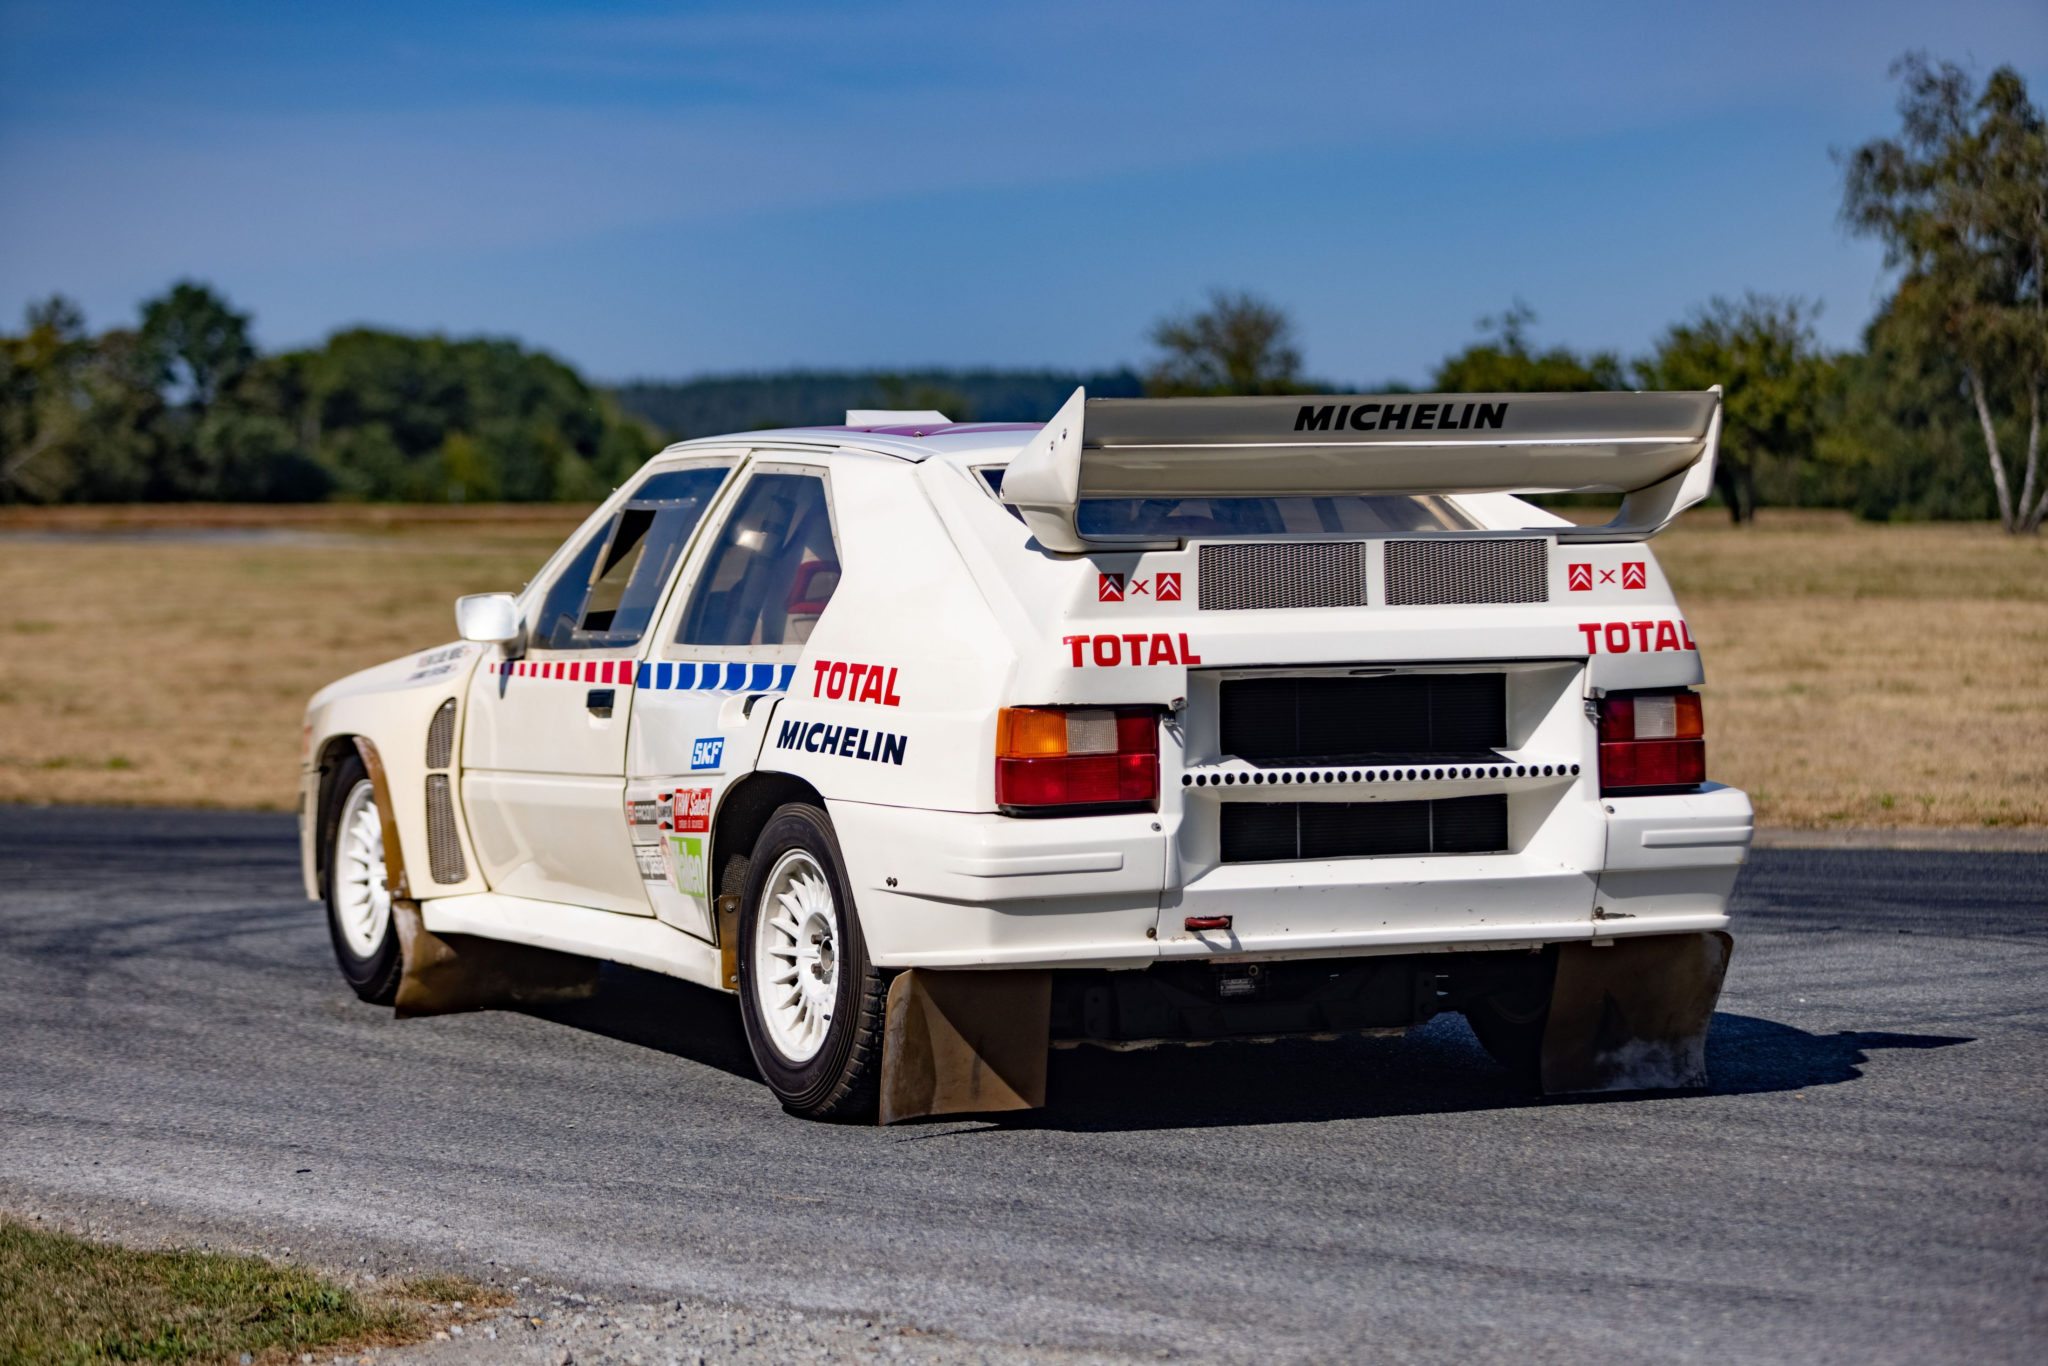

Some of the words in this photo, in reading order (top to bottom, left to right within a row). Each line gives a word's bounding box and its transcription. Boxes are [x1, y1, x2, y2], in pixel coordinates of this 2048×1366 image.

[1293, 403, 1509, 431] MICHELIN
[1062, 633, 1201, 667] TOTAL
[1579, 620, 1697, 655] TOTAL
[813, 660, 900, 706] TOTAL
[692, 741, 723, 766] SKF
[776, 720, 908, 766] MICHELIN
